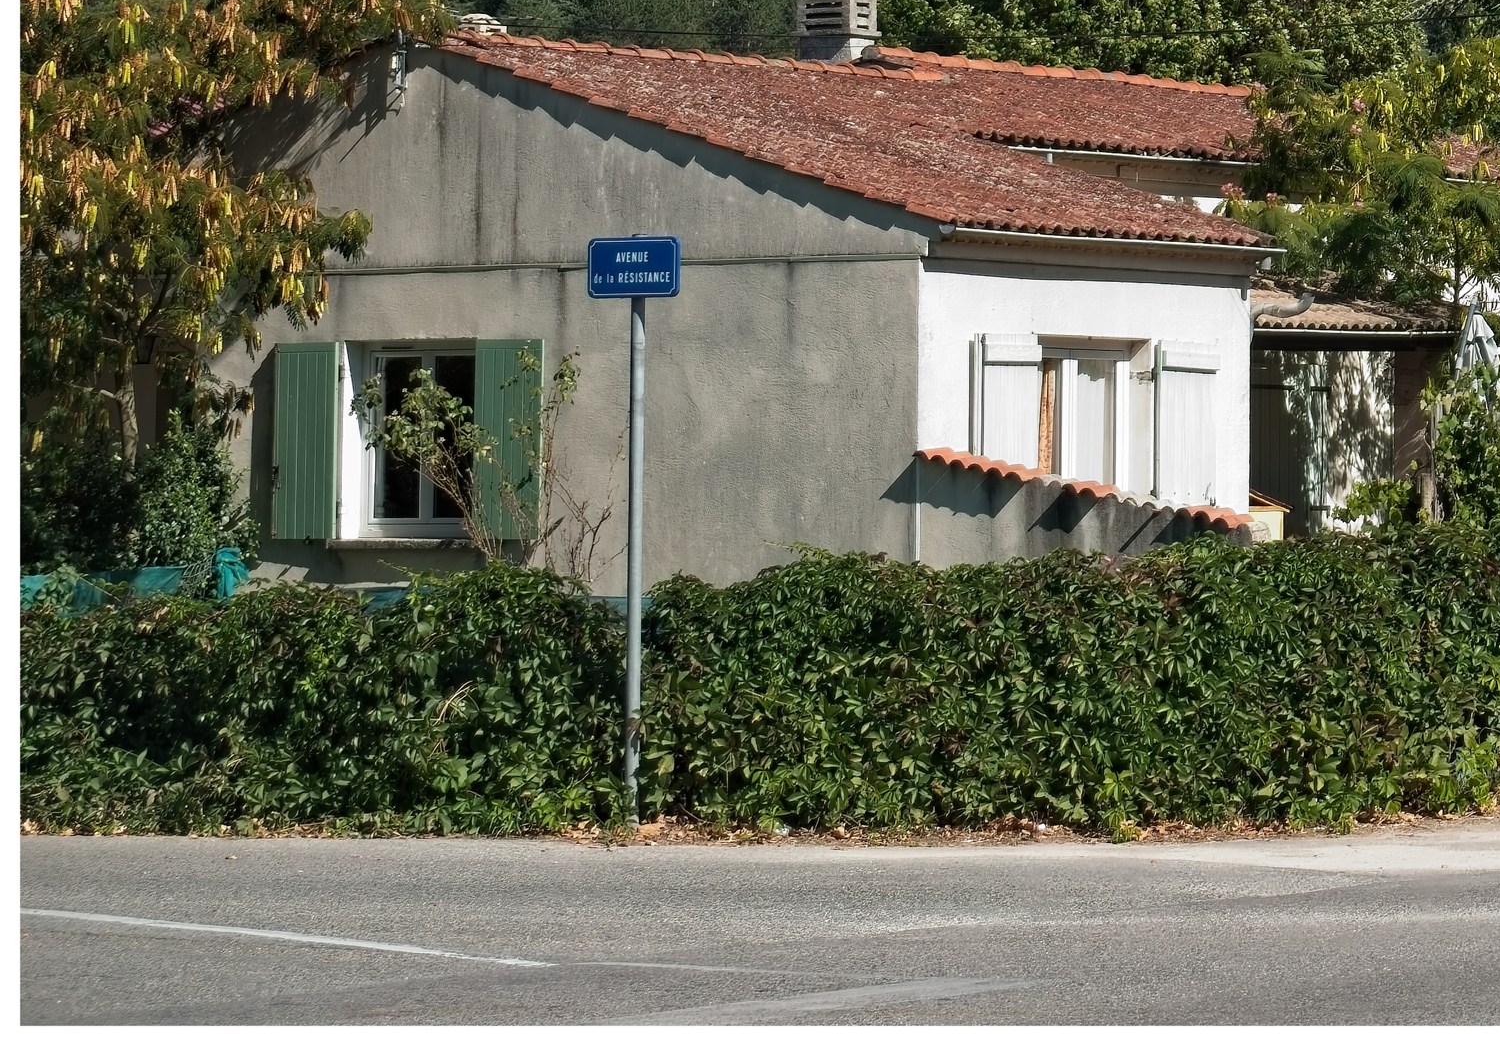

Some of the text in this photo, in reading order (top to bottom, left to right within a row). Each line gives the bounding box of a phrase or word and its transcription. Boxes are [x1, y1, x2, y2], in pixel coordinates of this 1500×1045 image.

[616, 251, 649, 263] AVENUE
[594, 271, 670, 283] de la RÉSISTANCE
